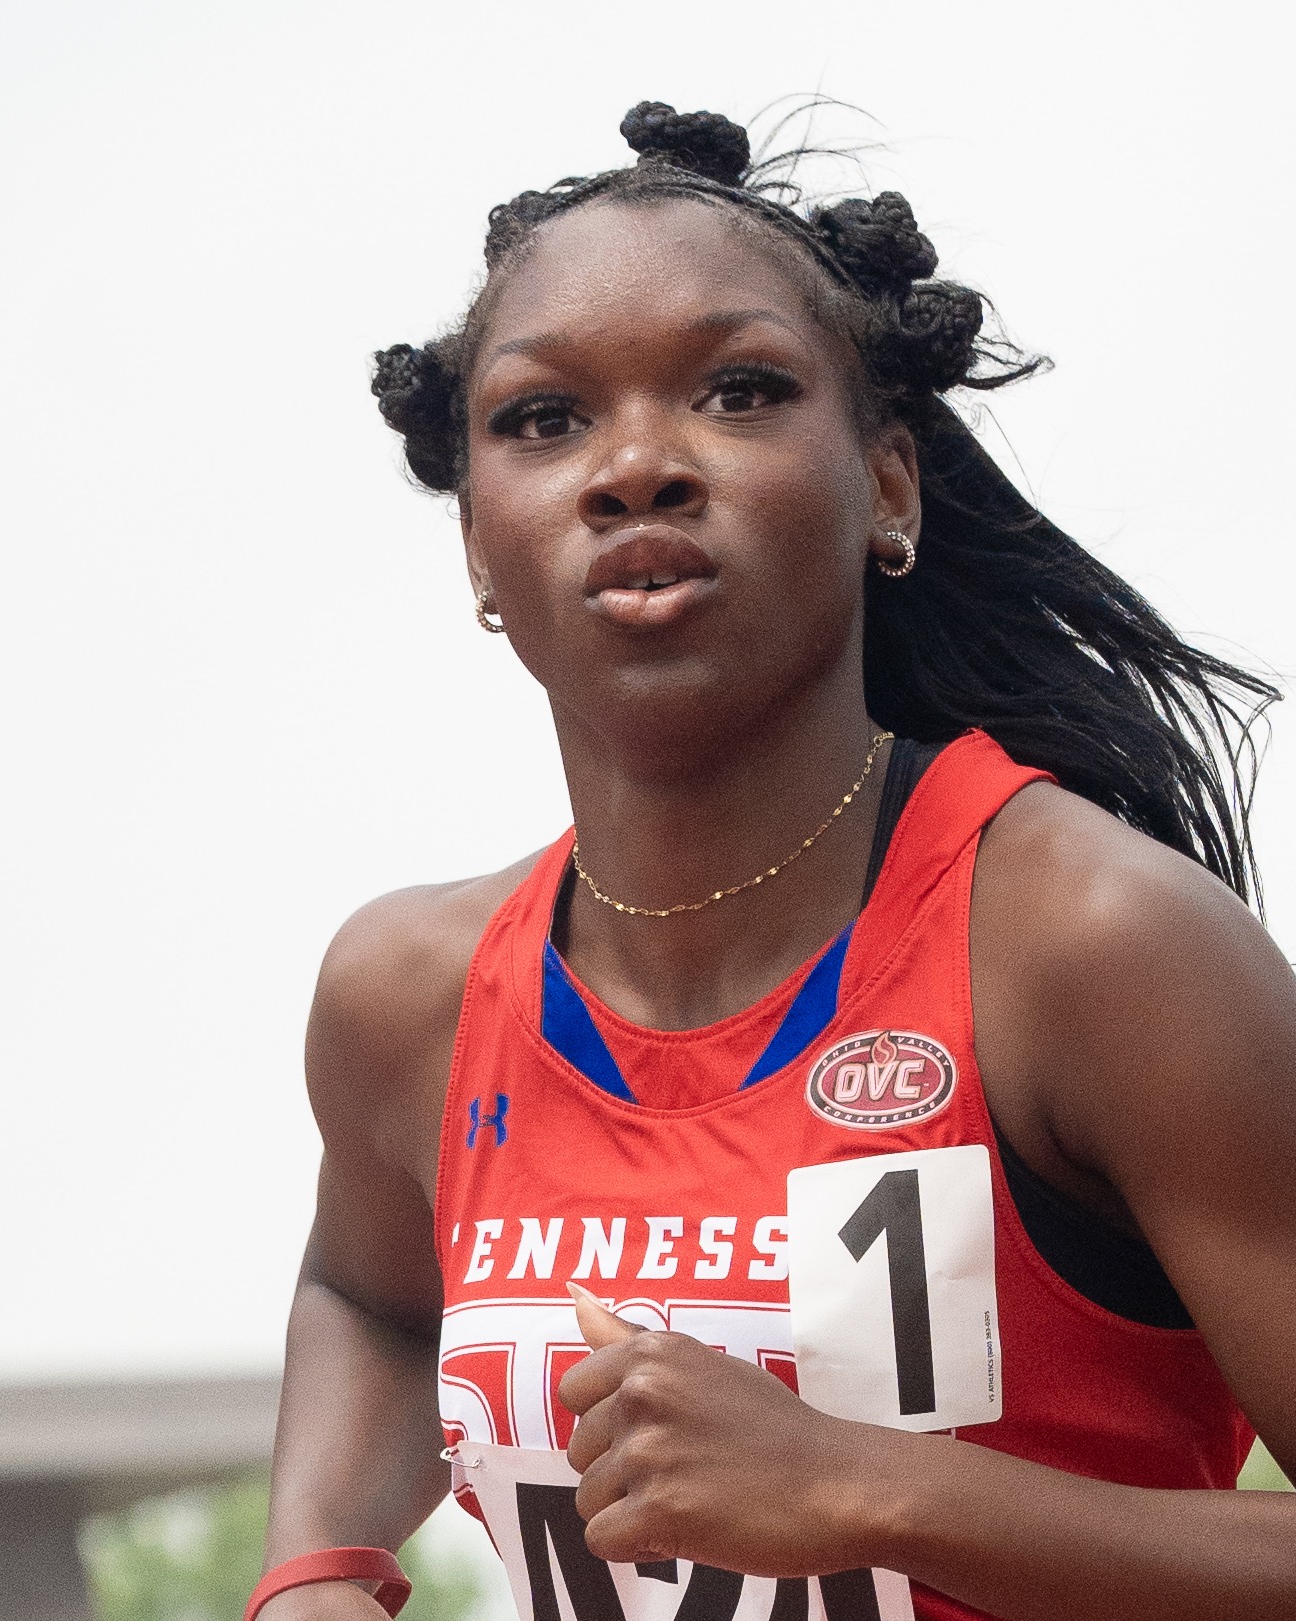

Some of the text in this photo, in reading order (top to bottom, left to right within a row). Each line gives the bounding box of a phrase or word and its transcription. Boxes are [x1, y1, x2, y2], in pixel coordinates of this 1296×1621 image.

[821, 1036, 951, 1067] OHIO VALLEY
[834, 1058, 926, 1103] OVC
[823, 1101, 936, 1124] CONFERENCE
[451, 1215, 789, 1285] ENNESS
[837, 1168, 937, 1417] 1
